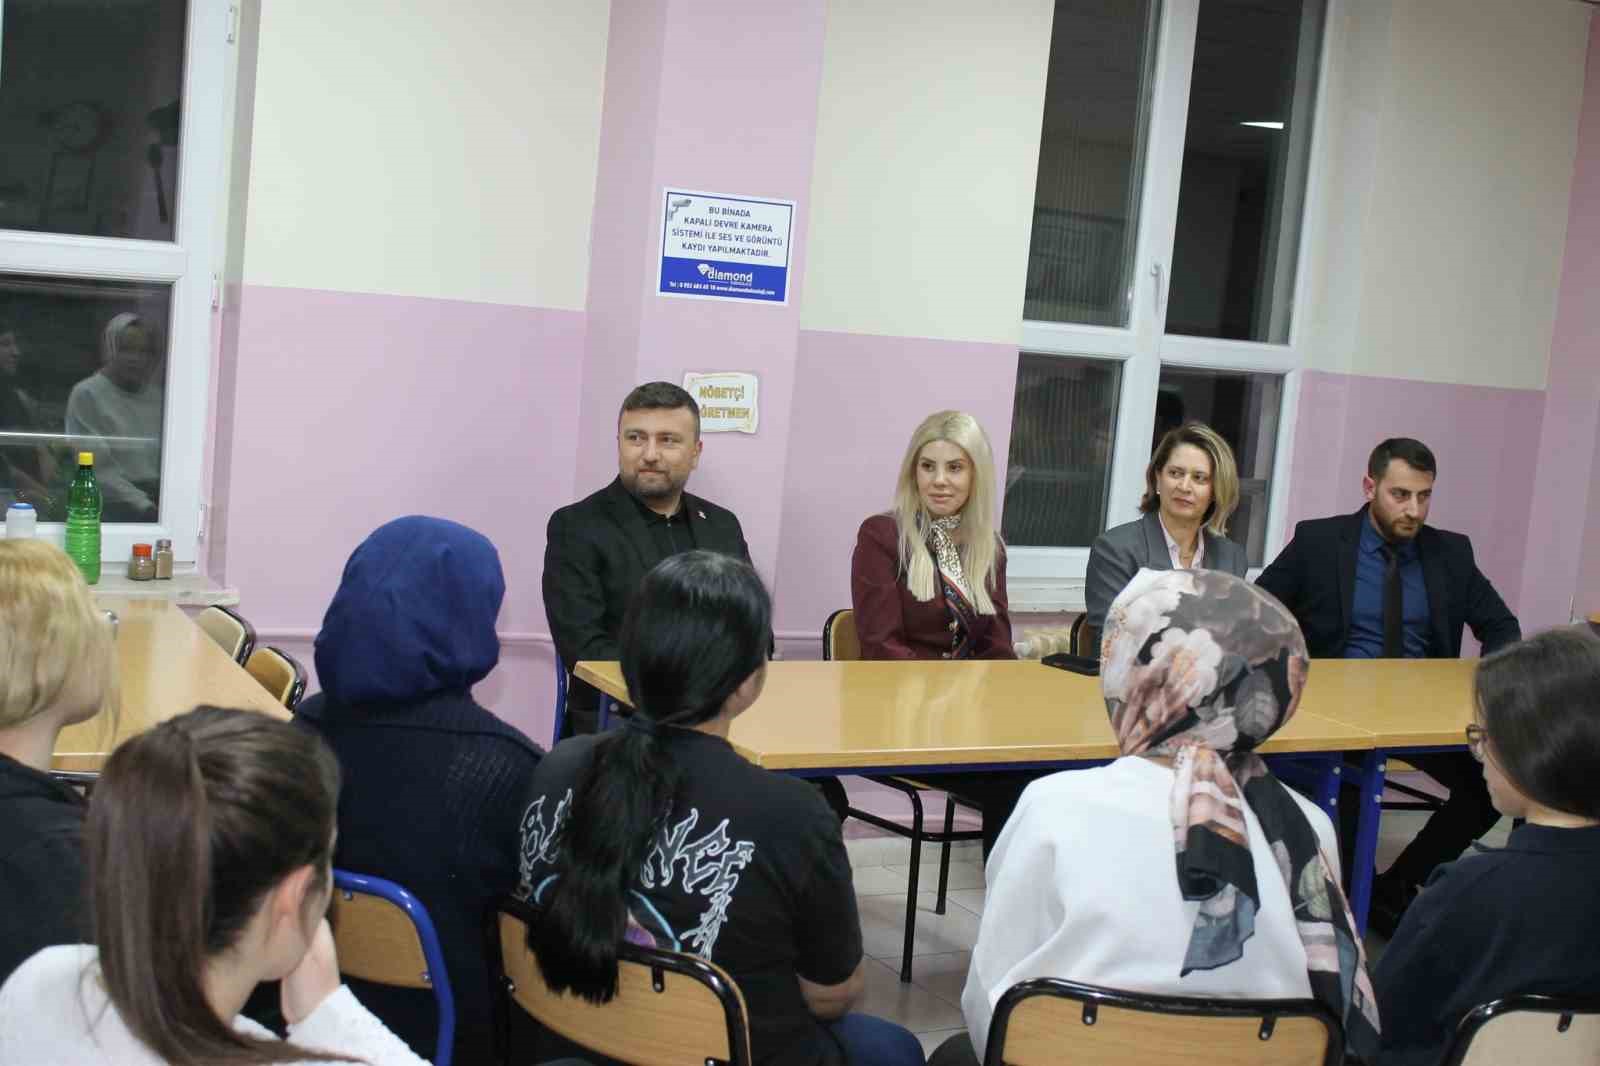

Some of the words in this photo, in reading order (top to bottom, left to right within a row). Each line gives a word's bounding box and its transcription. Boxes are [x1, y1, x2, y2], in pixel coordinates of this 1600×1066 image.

[708, 206, 720, 215] BU
[722, 207, 751, 218] BİNADA
[714, 219, 739, 230] DEVRE
[740, 222, 773, 233] KAMERA
[671, 228, 703, 239] SİSTEMİ
[718, 232, 733, 242] SES
[734, 234, 745, 243] VE
[746, 234, 783, 247] GÖRÜNTÜ
[681, 242, 705, 252] KAYDI
[707, 267, 753, 282] diamond
[699, 384, 745, 401] NÖBETÇİ
[700, 404, 751, 419] ĞRETMEN
